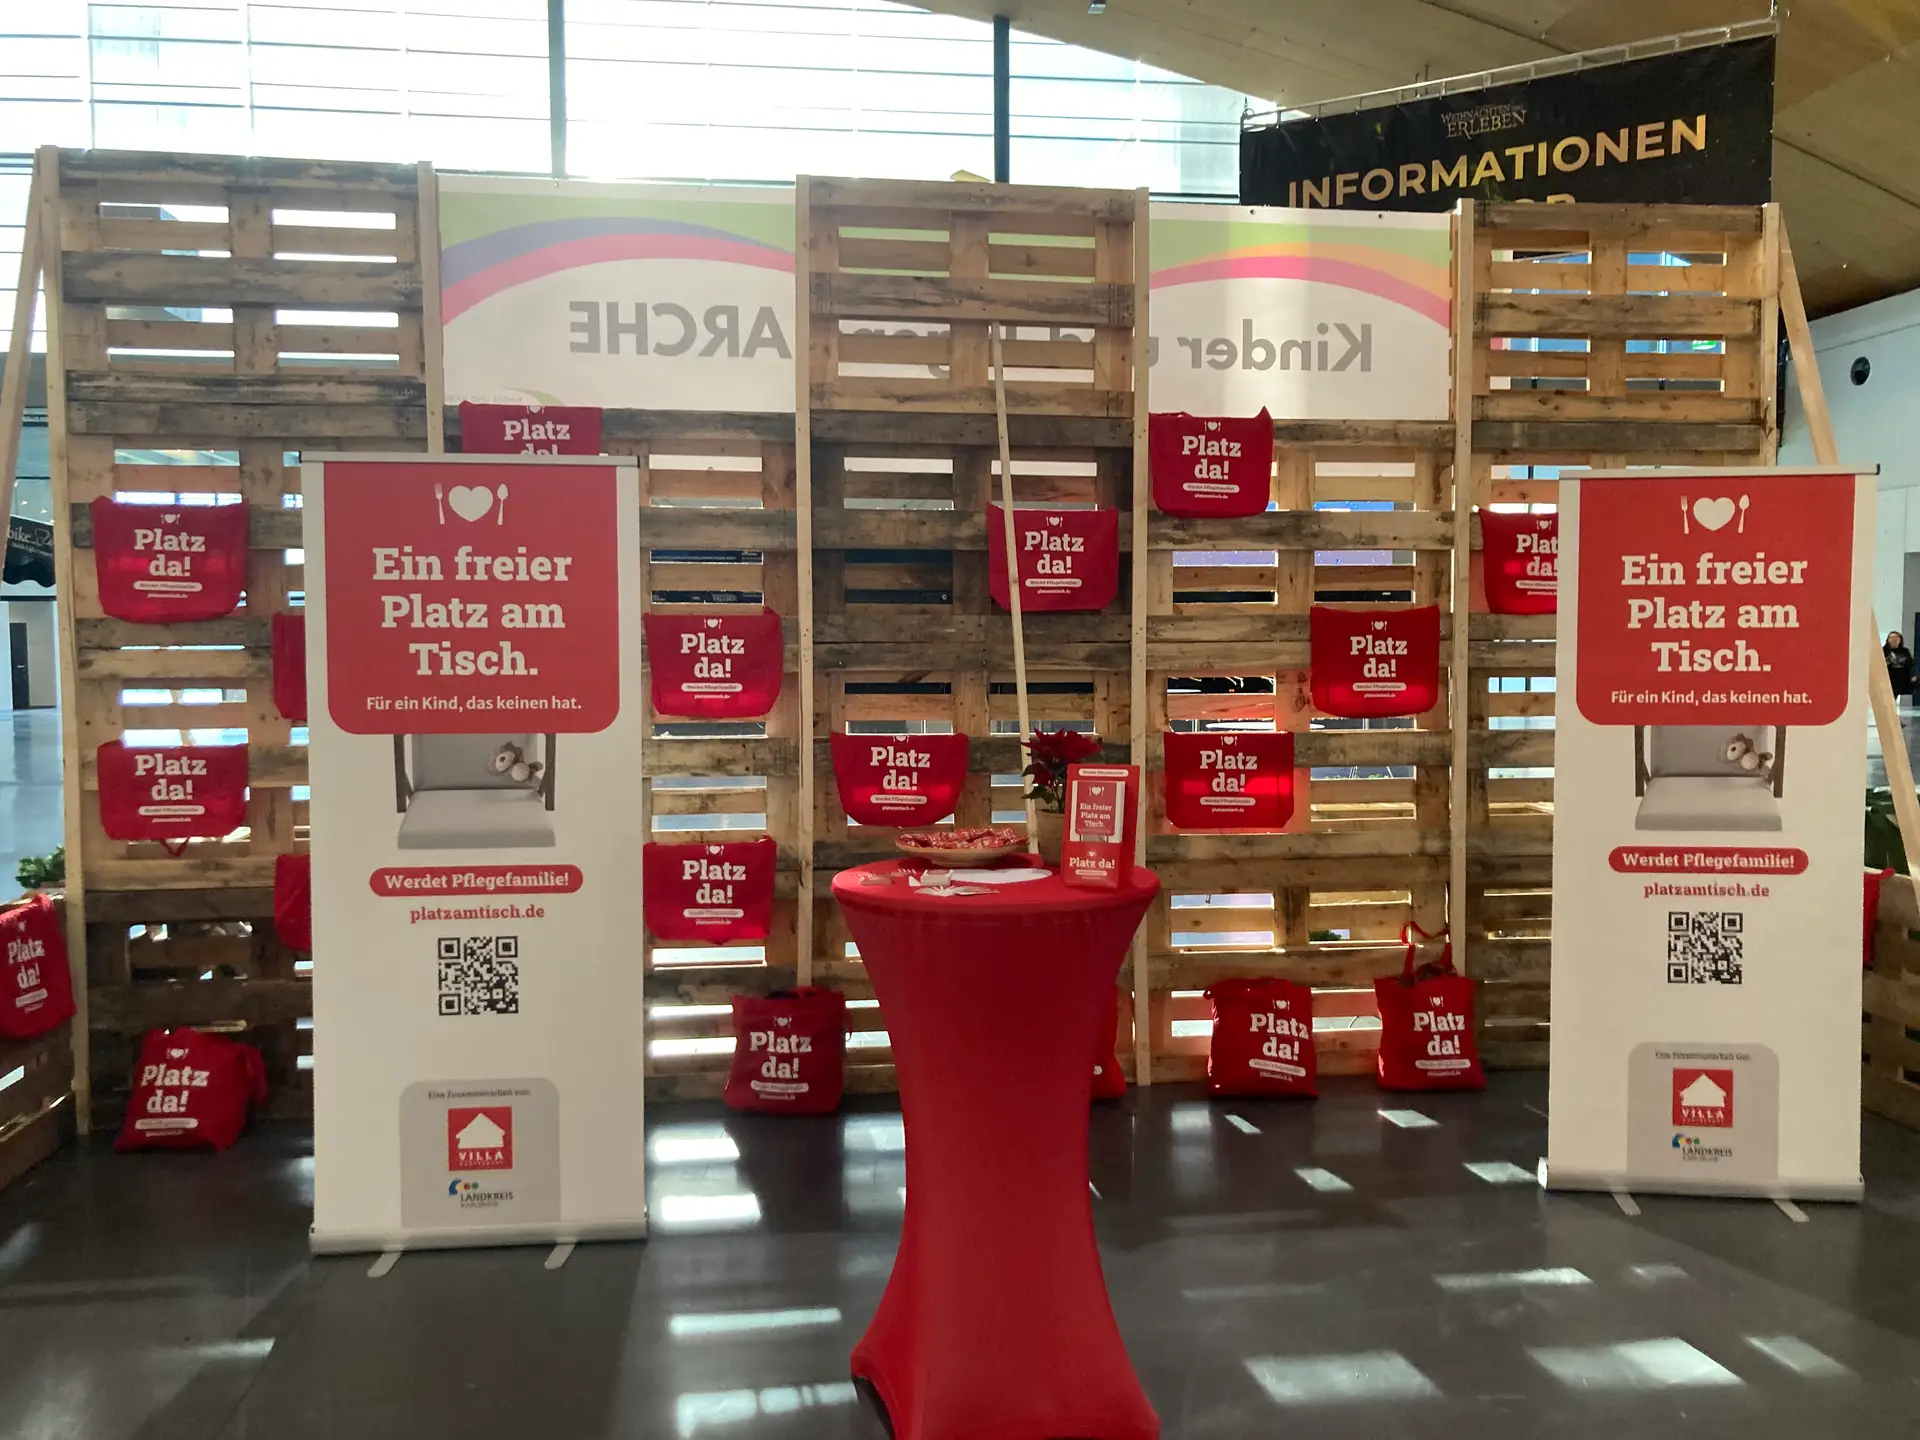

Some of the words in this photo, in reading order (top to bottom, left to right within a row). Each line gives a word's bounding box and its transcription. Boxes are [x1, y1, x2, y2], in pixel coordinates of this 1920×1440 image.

[1446, 109, 1527, 140] ERLEBEN
[1288, 114, 1707, 208] INFORMATIONEN
[503, 418, 571, 441] Platz
[1182, 435, 1241, 457] Platz
[1194, 458, 1229, 480] da!
[134, 528, 206, 552] Platz
[1024, 530, 1084, 552] Platz
[1516, 533, 1559, 554] Plat
[150, 554, 191, 577] da!
[372, 545, 444, 581] Ein
[454, 546, 572, 581] freier
[1036, 554, 1072, 574] da!
[1621, 553, 1685, 586] Ein
[1696, 552, 1808, 585] freier
[381, 593, 488, 629] Platz
[501, 602, 566, 629] am
[1627, 597, 1725, 629] Platz
[1737, 603, 1800, 629] am
[681, 633, 744, 655] Platz
[1350, 634, 1408, 655] Platz
[409, 641, 539, 676] Tisch.
[1651, 640, 1772, 672] Tisch.
[694, 657, 731, 678] da!
[1363, 658, 1397, 678] da!
[366, 696, 391, 710] Für
[395, 696, 419, 710] ein
[422, 696, 463, 713] Kind,
[466, 696, 494, 710] das
[496, 696, 549, 710] keinen
[552, 696, 582, 710] hat.
[1611, 691, 1634, 704] Für
[1636, 691, 1658, 704] ein
[1661, 690, 1699, 706] Kind,
[1702, 691, 1727, 704] das
[1730, 691, 1781, 704] keinen
[1783, 691, 1812, 704] hat.
[134, 753, 207, 776] Platz
[870, 746, 930, 768] Platz
[1200, 749, 1257, 770] Platz
[151, 778, 193, 801] da!
[882, 769, 918, 791] da!
[1212, 772, 1246, 792] da!
[682, 859, 746, 880] Platz
[1069, 857, 1096, 869] Platz
[1098, 858, 1115, 869] da!
[1622, 853, 1680, 867] Werdet
[1683, 853, 1795, 869] Pflegefamilie!
[384, 874, 448, 889] Werdet
[452, 872, 569, 890] Pflegefamilie!
[1644, 881, 1770, 898] platzamtisch.de
[696, 883, 733, 904] da!
[410, 904, 545, 924] platzamtisch.de
[8, 937, 45, 965] Platz
[17, 962, 41, 989] da!
[1250, 1012, 1309, 1040] Platz
[1413, 1011, 1466, 1033] Platz
[749, 1030, 812, 1054] Platz
[1262, 1036, 1300, 1061] da!
[1427, 1034, 1461, 1056] da!
[141, 1063, 210, 1087] Platz
[761, 1055, 799, 1079] da!
[146, 1089, 189, 1113] da!
[1681, 1107, 1725, 1120] VILLA
[459, 1151, 504, 1161] VILLA
[1682, 1147, 1733, 1157] LANDKREIS
[460, 1191, 514, 1202] LANDKREIS
